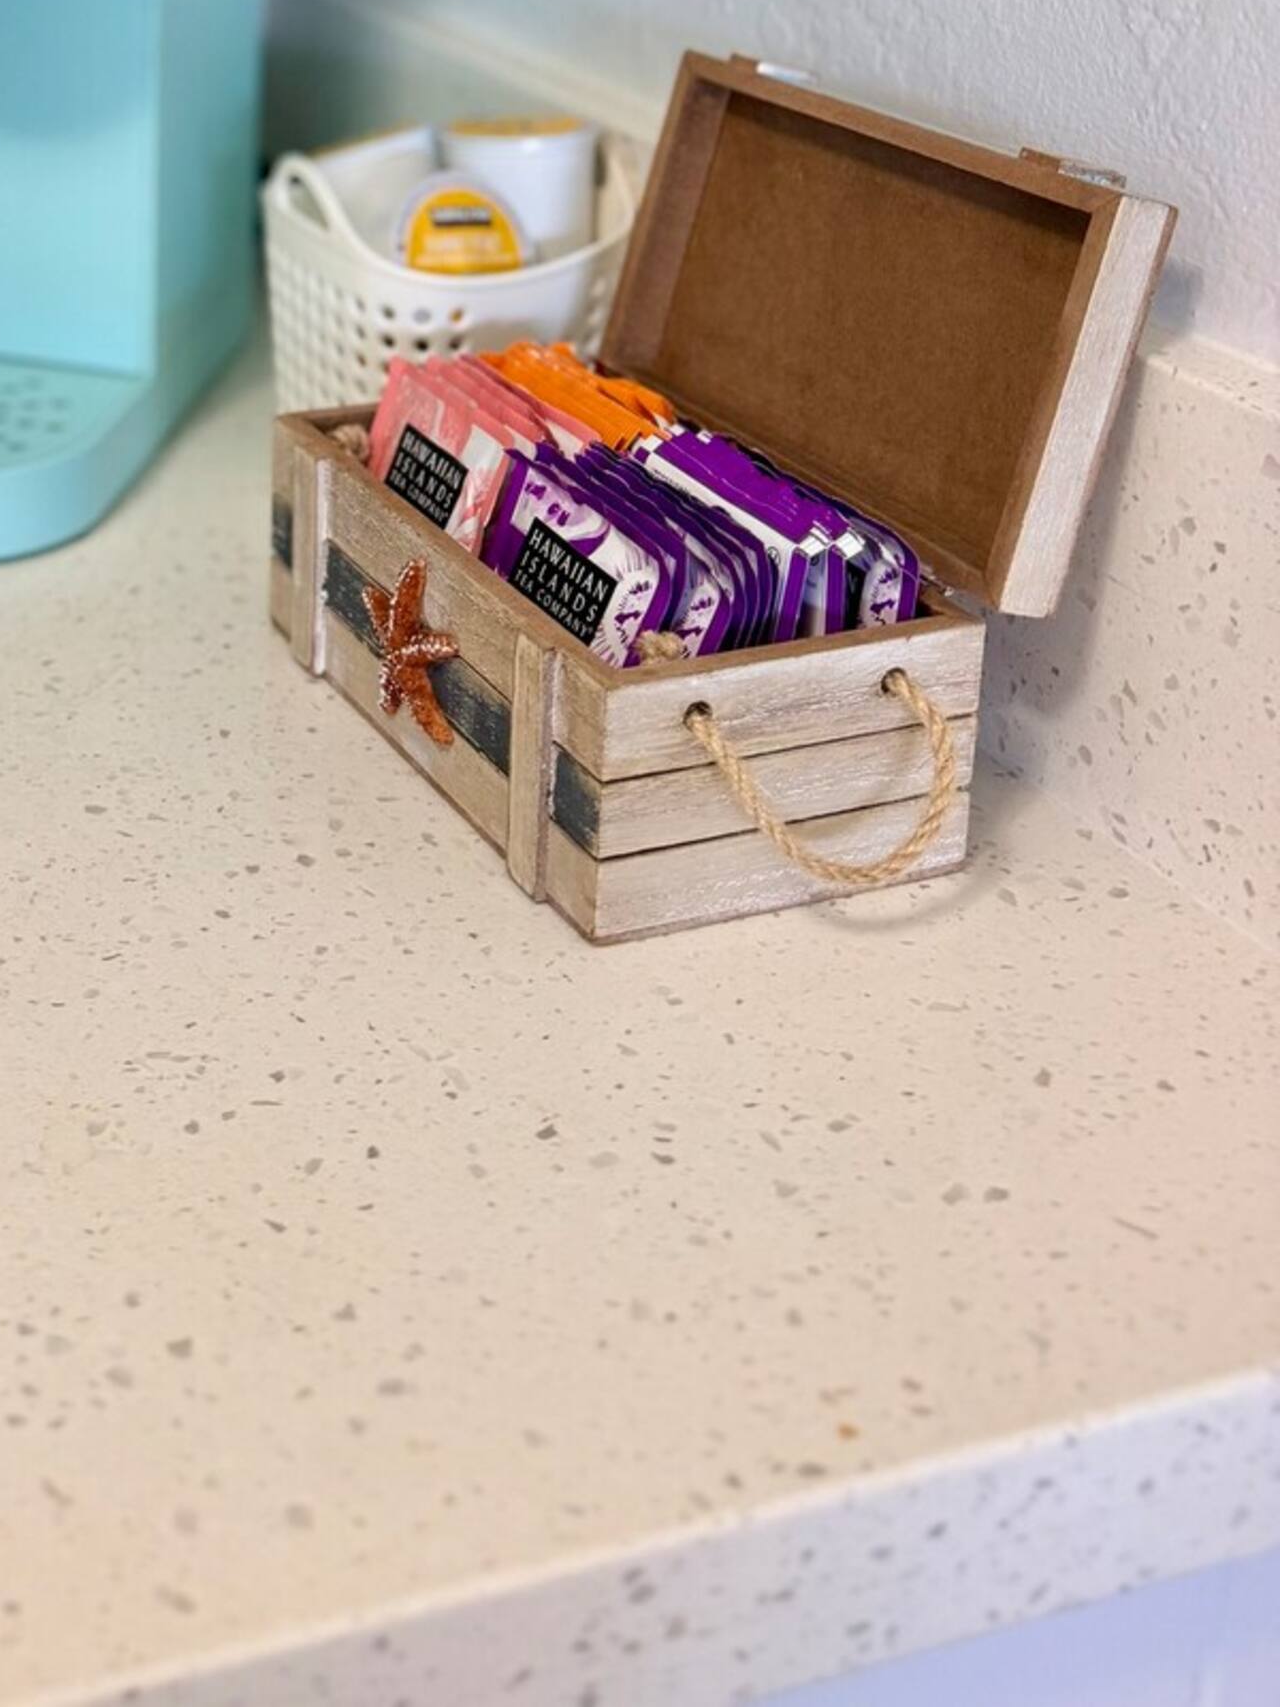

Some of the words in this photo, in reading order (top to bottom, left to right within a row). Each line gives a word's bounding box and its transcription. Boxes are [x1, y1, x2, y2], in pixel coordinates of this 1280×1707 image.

[389, 468, 407, 490] TEA
[394, 451, 453, 509] ISLANDS
[401, 431, 462, 490] HAWAIIAN
[514, 569, 534, 593] TEA
[520, 550, 598, 623] ISLANDS
[528, 528, 609, 602] HAWAIIAN
